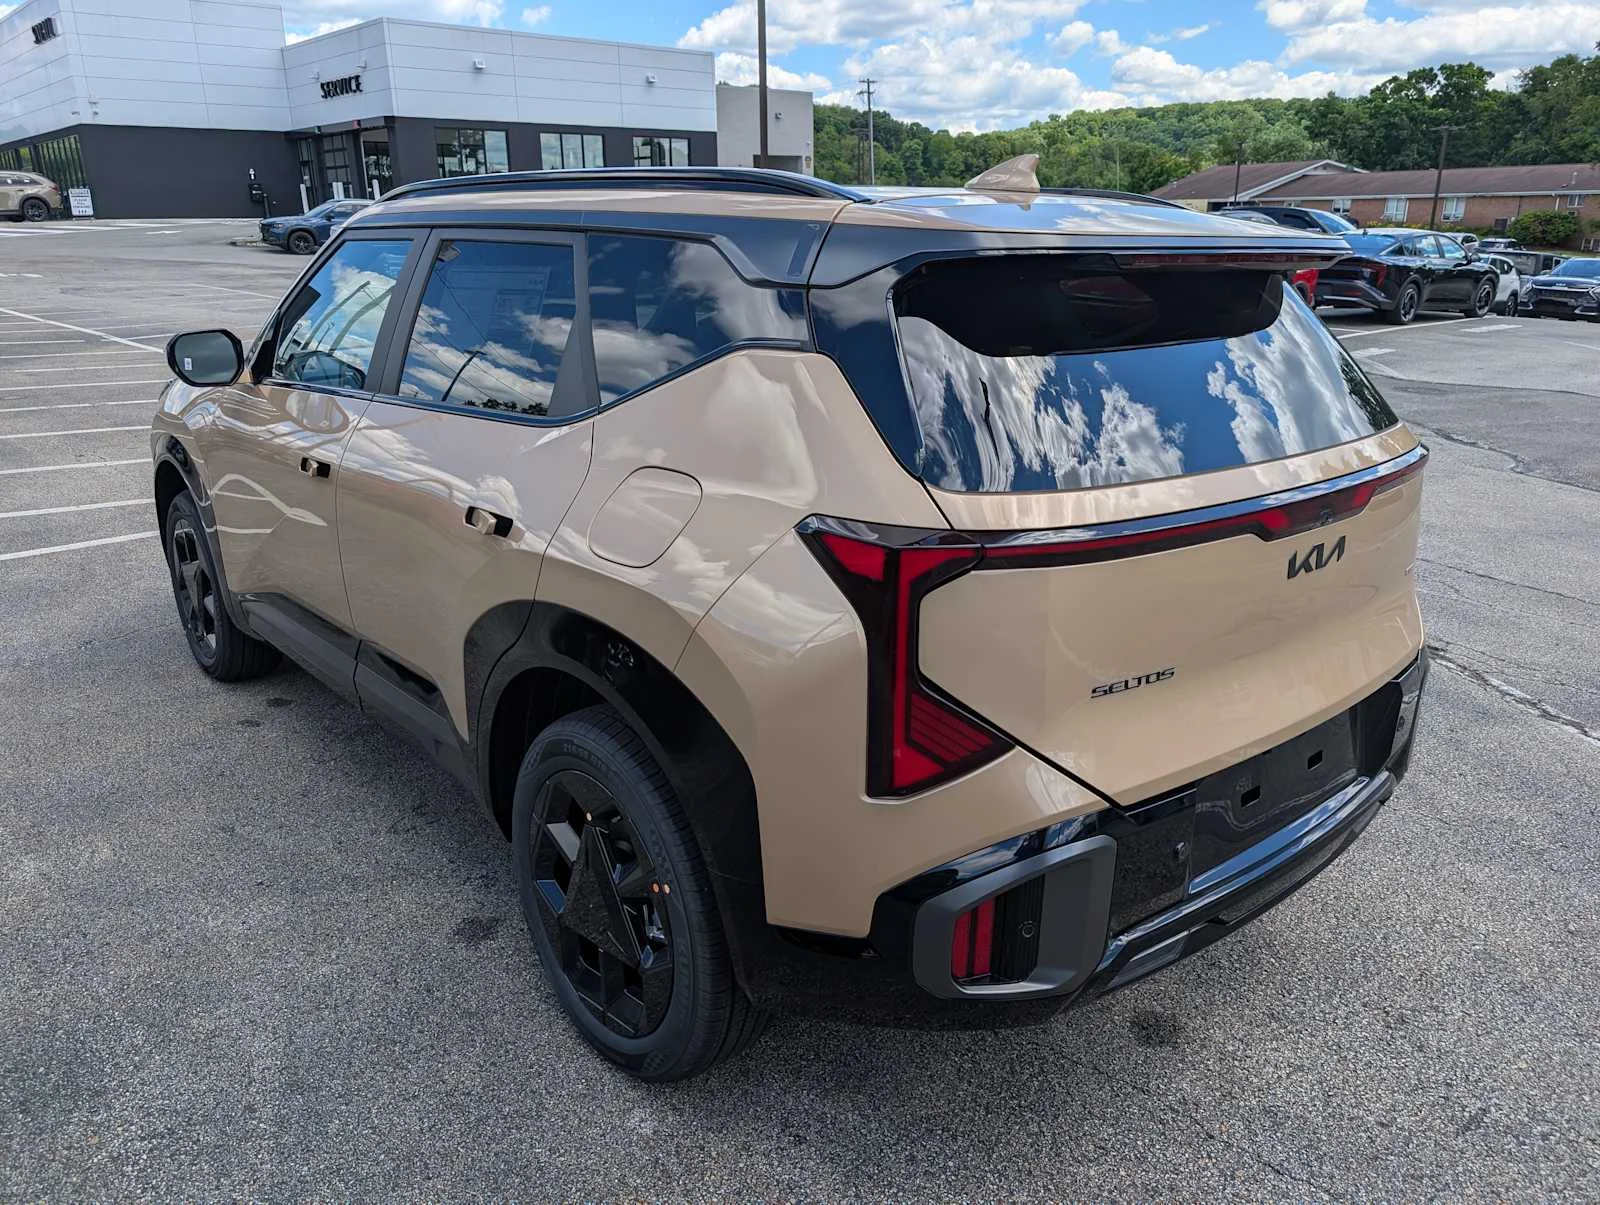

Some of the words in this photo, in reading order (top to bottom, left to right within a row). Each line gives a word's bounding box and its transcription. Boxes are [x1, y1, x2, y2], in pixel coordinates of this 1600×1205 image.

[320, 75, 363, 99] SERVICE
[1287, 535, 1346, 580] KIA
[1090, 667, 1176, 699] SELTOS
